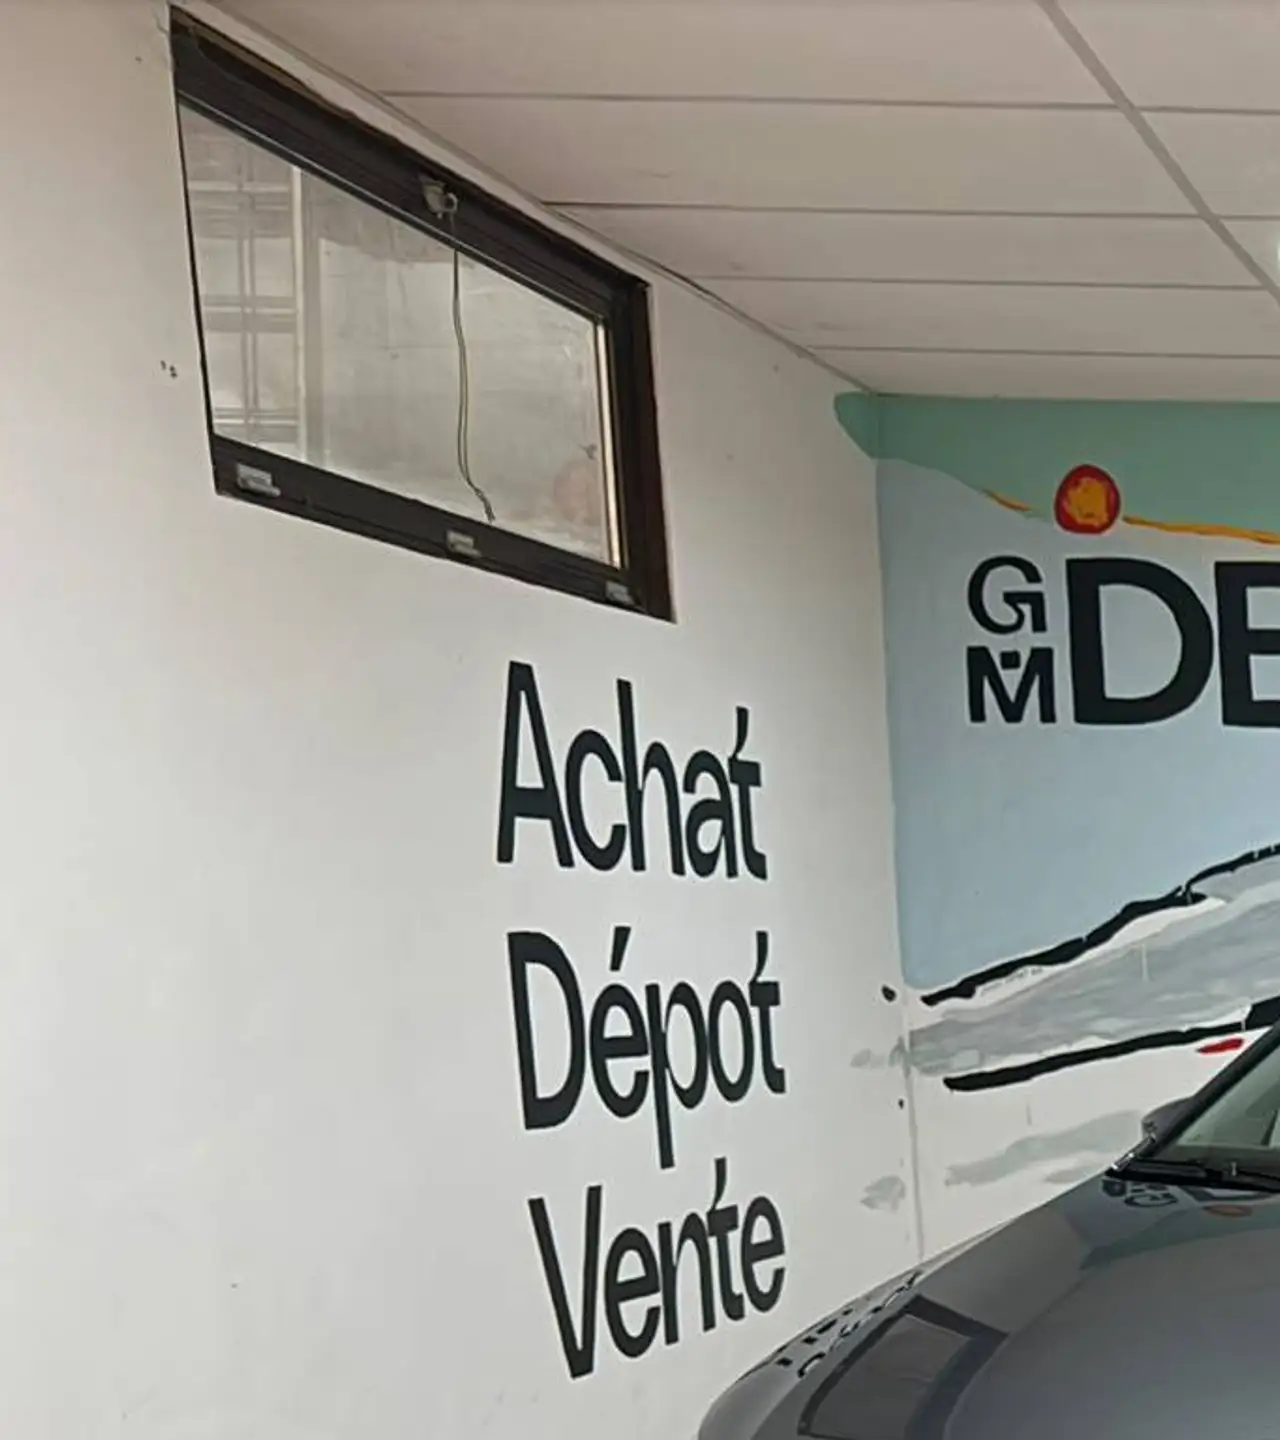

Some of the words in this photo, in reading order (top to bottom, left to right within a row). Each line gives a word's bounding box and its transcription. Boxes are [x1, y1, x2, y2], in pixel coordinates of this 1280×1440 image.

[496, 660, 768, 880] Achat
[507, 926, 786, 1170] Dépot
[528, 1157, 786, 1380] Vente
